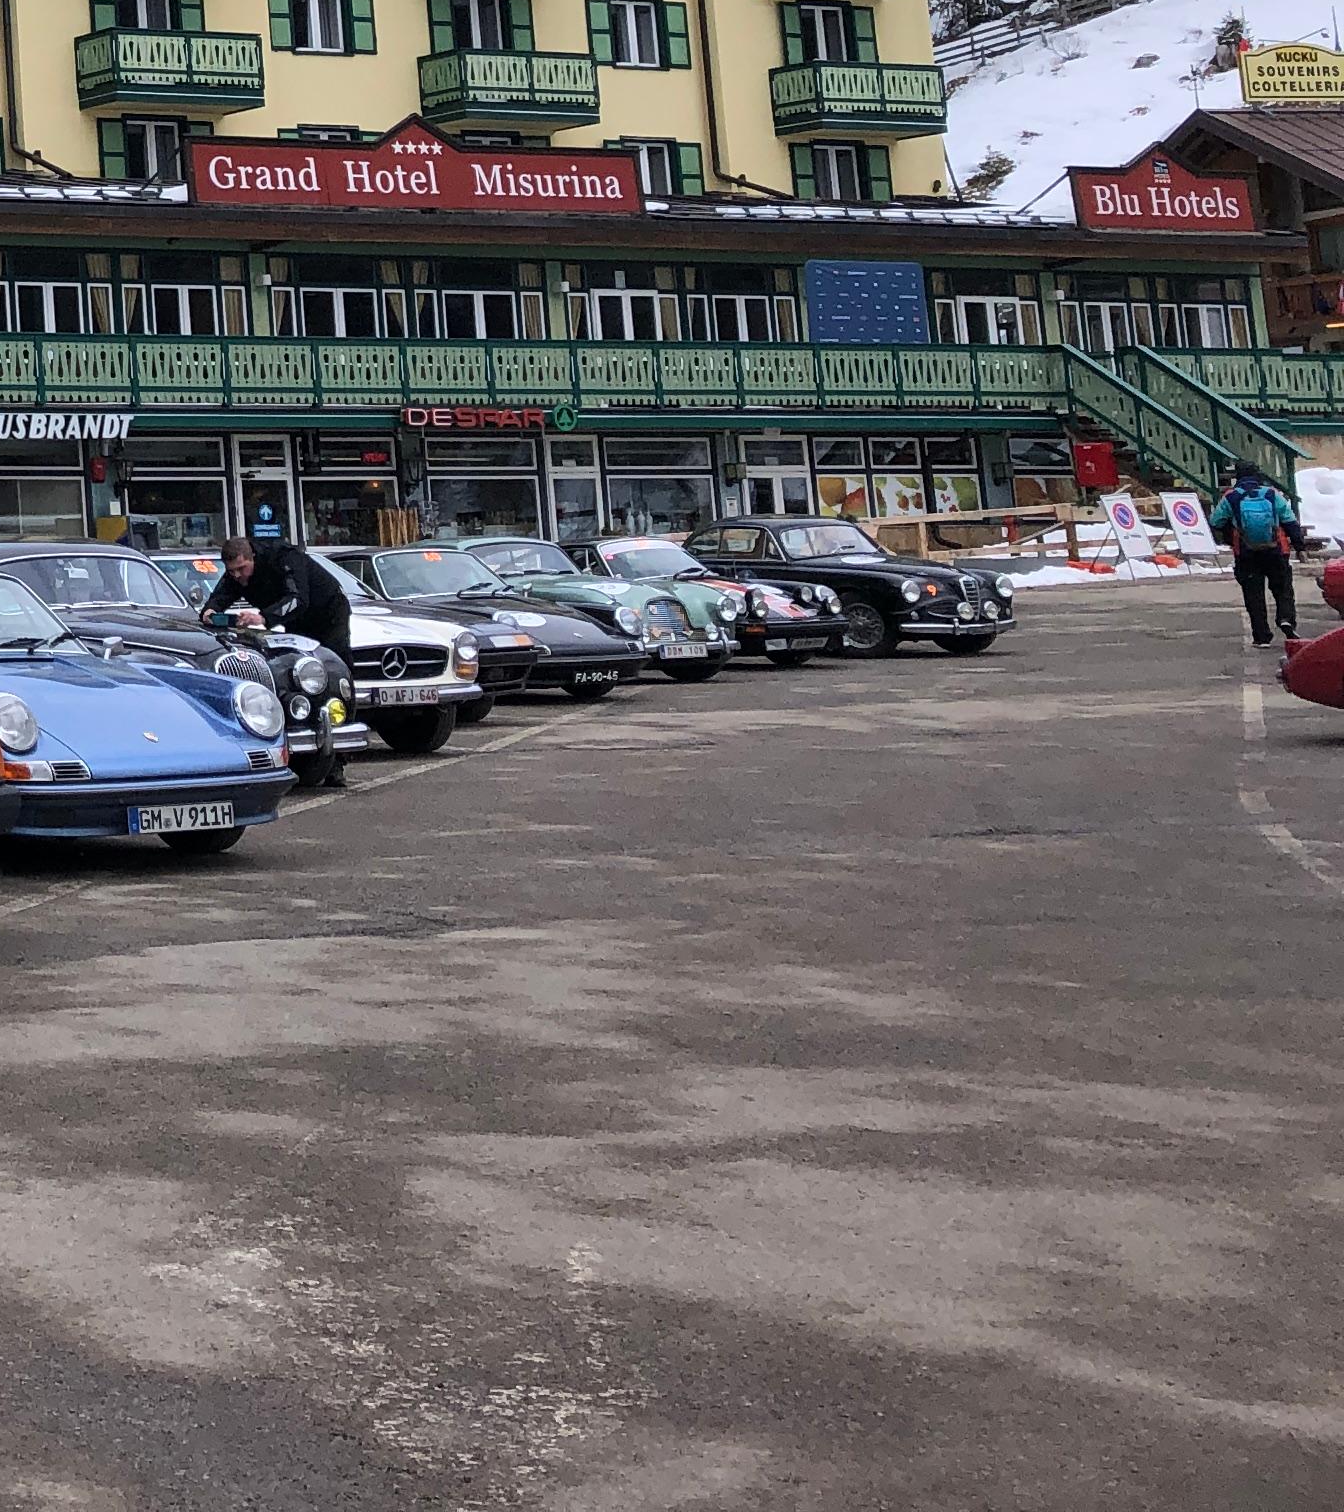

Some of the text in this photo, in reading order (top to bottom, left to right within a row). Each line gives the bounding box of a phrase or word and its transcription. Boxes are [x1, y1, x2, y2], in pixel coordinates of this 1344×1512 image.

[1257, 65, 1340, 78] SOUVENIRS
[209, 156, 624, 200] Grand Hotel Misurina
[1092, 183, 1241, 220] Blu Hotels
[406, 407, 546, 429] DESPAR
[139, 804, 233, 831] GM V 911H
